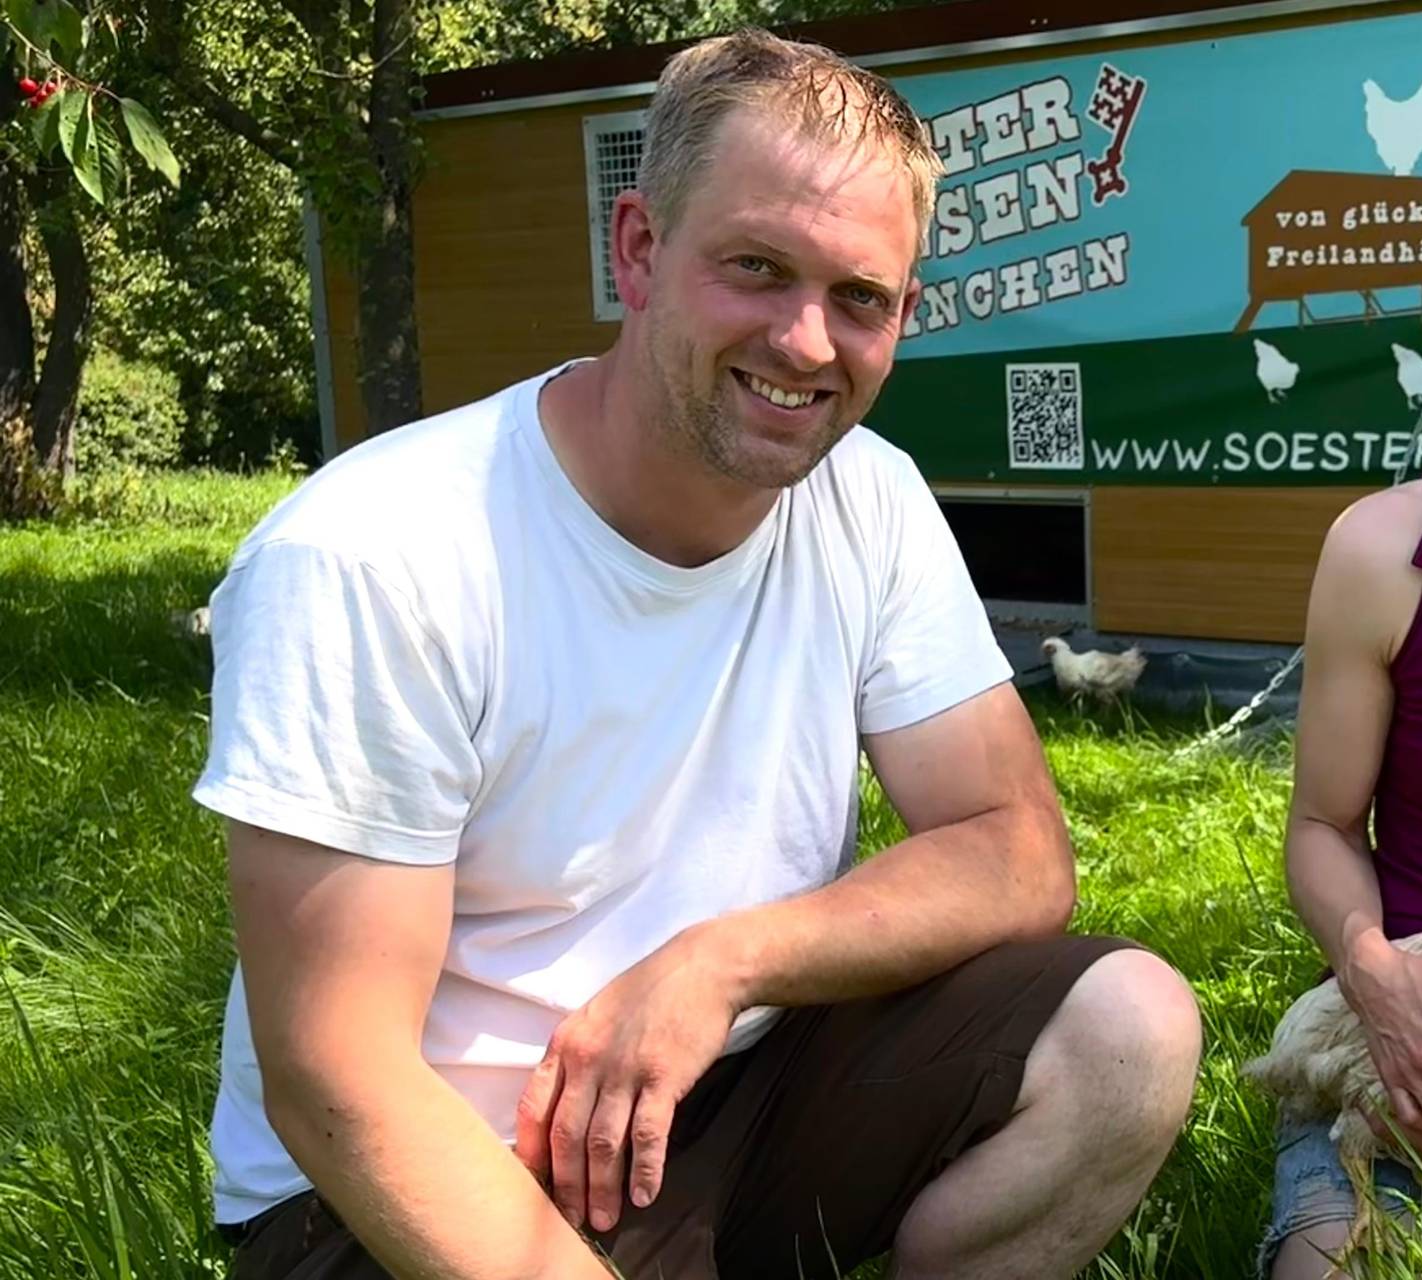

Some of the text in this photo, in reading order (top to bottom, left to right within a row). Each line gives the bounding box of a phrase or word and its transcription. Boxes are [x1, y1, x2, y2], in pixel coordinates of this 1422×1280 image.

[923, 75, 1082, 177] TER
[920, 150, 1085, 259] SEN
[1275, 209, 1327, 229] von
[901, 232, 1129, 340] NCHEN
